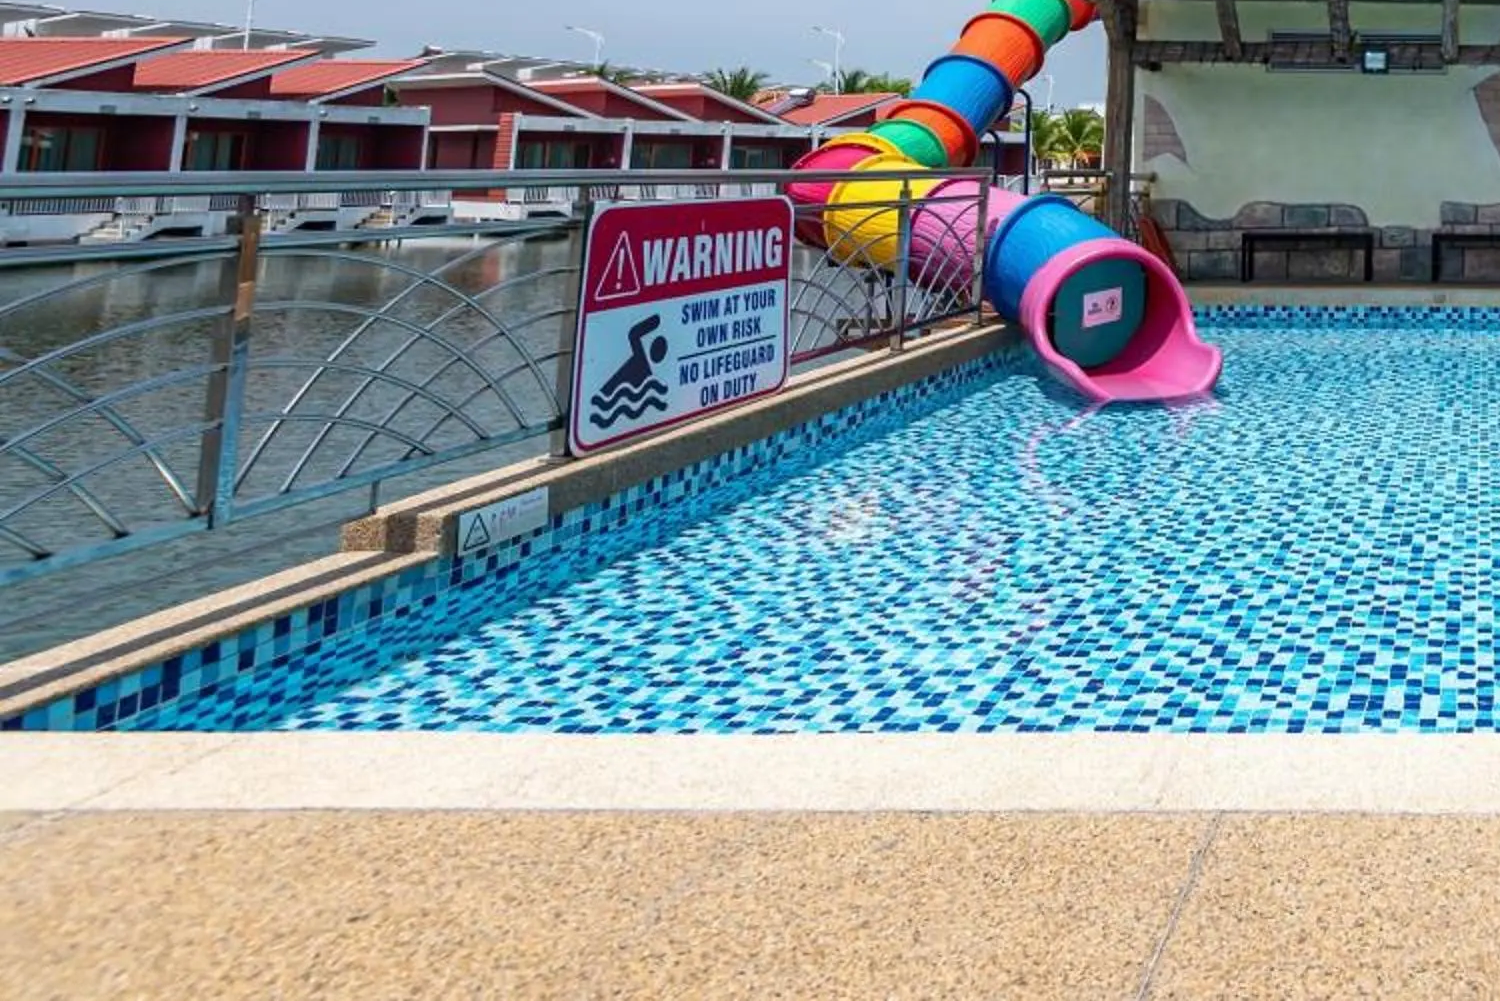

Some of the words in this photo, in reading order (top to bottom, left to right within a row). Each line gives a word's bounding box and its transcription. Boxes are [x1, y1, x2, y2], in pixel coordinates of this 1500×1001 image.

[643, 226, 783, 286] WARNING
[681, 298, 720, 325] SWIM
[723, 294, 740, 316] AT
[743, 288, 776, 312] YOUR
[696, 323, 729, 348] OWN
[732, 315, 761, 340] RISK
[679, 362, 699, 386] NO
[703, 344, 775, 380] LIFEGUARD
[700, 383, 719, 407] ON
[723, 372, 757, 400] DUTY
